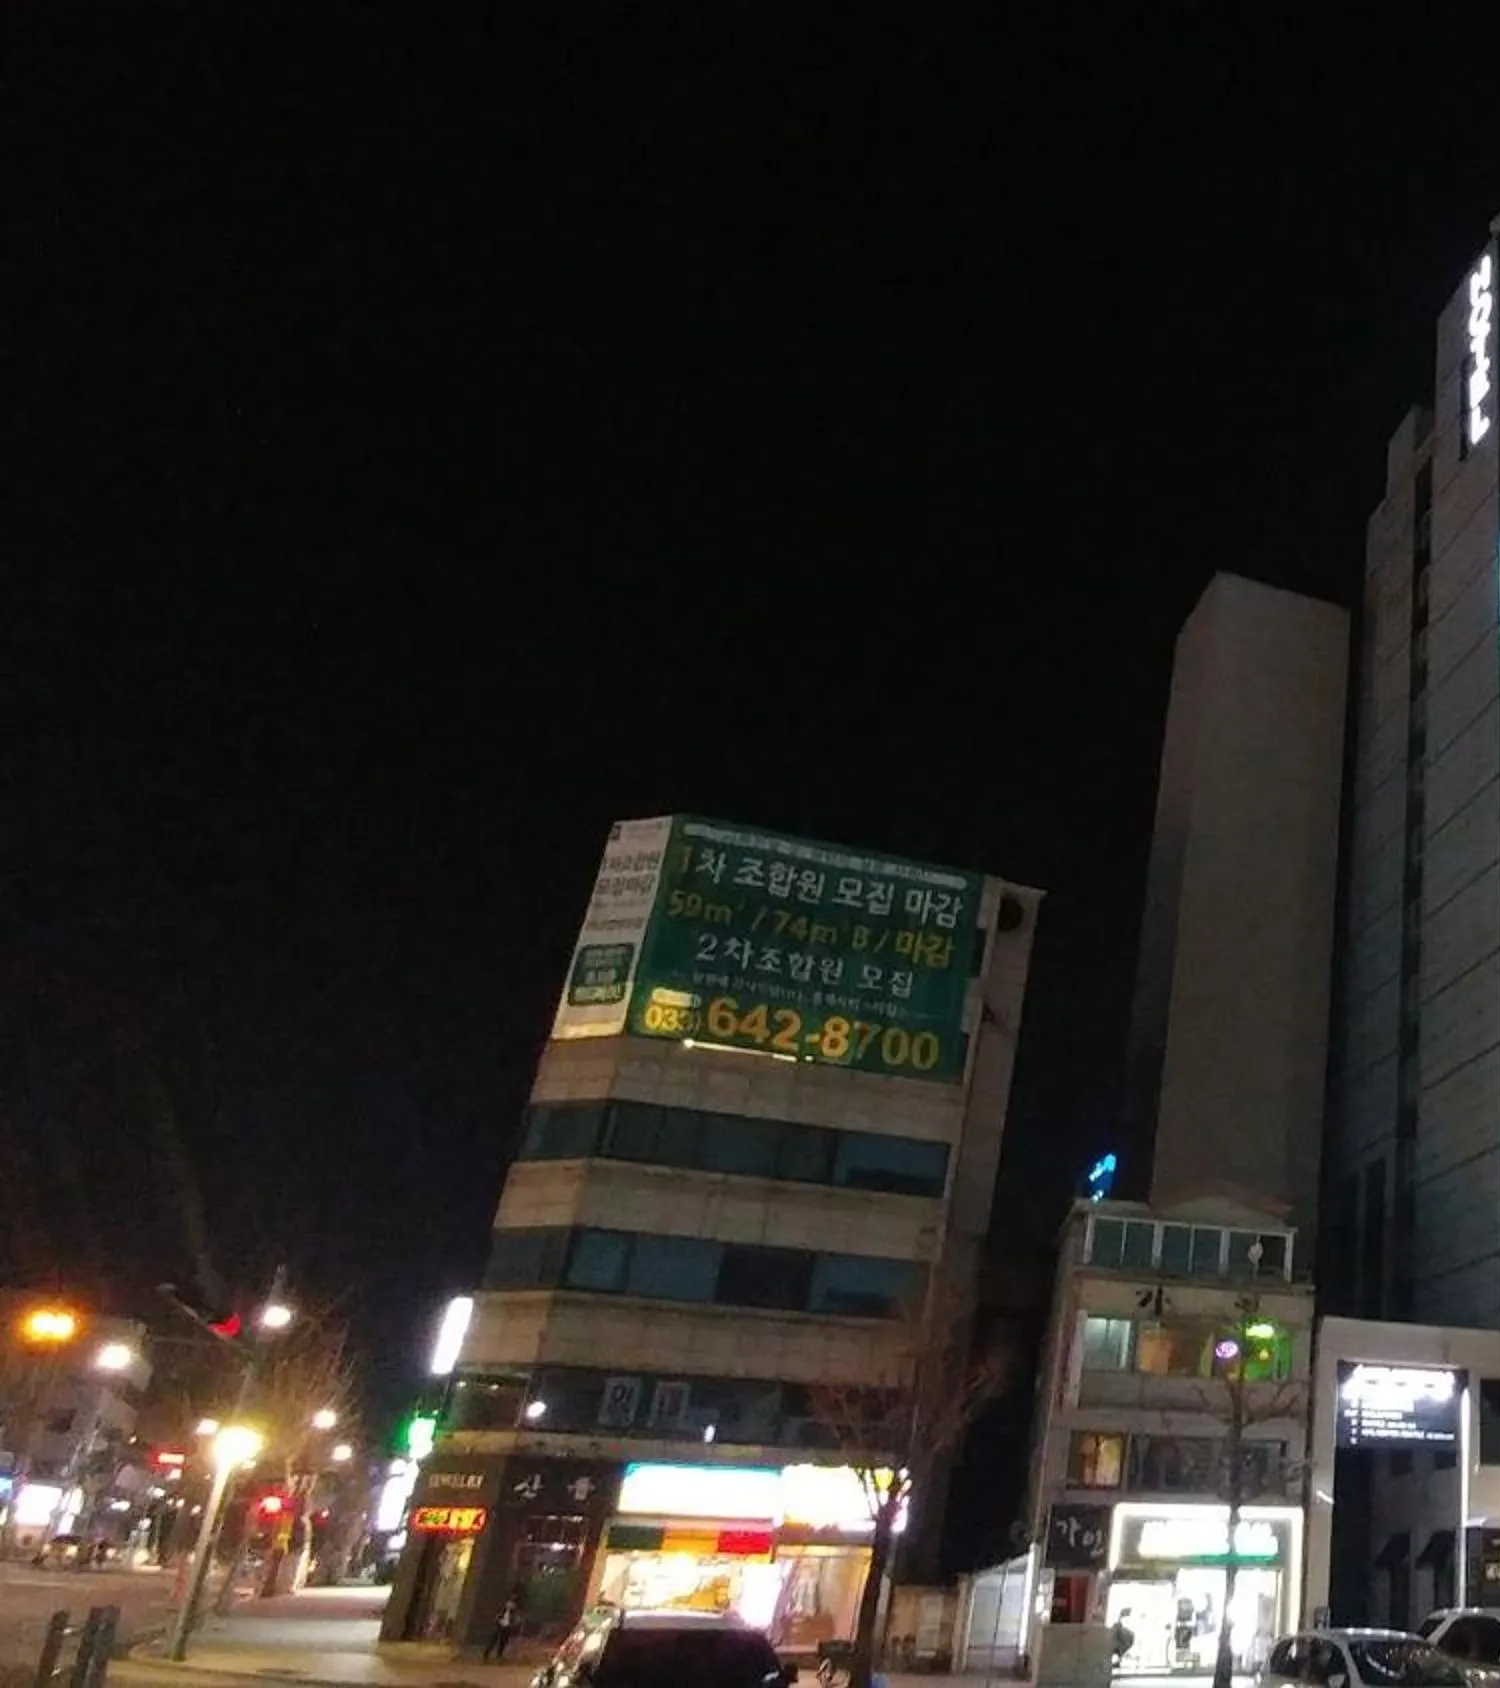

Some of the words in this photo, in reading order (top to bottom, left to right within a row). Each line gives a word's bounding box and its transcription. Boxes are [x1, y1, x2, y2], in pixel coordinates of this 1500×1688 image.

[732, 854, 825, 902] 조합원
[831, 875, 896, 913] 모집
[904, 887, 965, 931] 마감
[894, 930, 956, 969] 마감
[856, 963, 916, 999] 모집
[706, 993, 941, 1072] 642-8700
